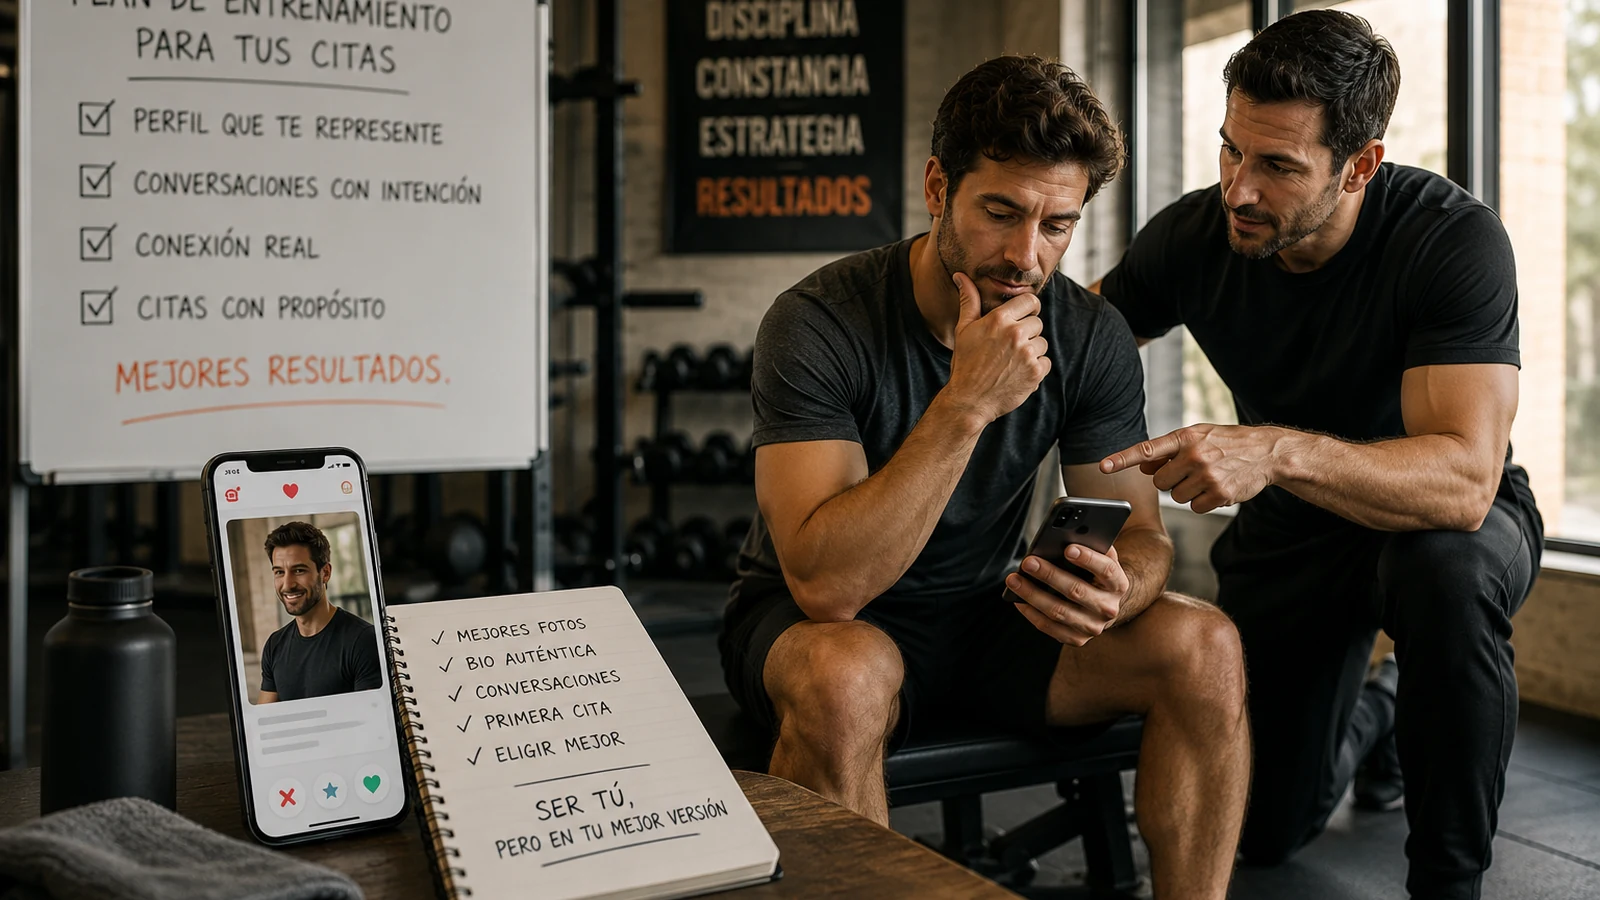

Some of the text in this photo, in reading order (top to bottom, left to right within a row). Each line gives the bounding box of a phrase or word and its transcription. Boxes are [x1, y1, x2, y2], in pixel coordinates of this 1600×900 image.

[706, 0, 860, 40] DISCIPLINA
[136, 26, 397, 75] PARA TUS CITAS
[696, 55, 870, 98] CONSTANCIA
[134, 107, 444, 146] PERFIL QUE TE REPRESENTE
[699, 115, 865, 157] ESTRATEGIA
[134, 170, 482, 205] CONVERSACIONES CON INTENCIÓN
[696, 176, 872, 217] RESULTADOS
[136, 226, 320, 259] CONEXIÓN REAL
[138, 289, 386, 321] CITAS CON PROPÓSITO
[115, 353, 450, 394] MEJORES RESULTADOS.
[456, 617, 587, 643] MEJORES FOTOS
[465, 643, 597, 671] BIO AUTÉNTICA
[475, 669, 621, 700] CONVERSACIONES
[484, 700, 613, 731] PRIMERA CITA
[495, 731, 626, 763] ELIGIR MEJOR
[535, 781, 634, 821] SER TÚ,
[494, 798, 729, 860] PERO EN TU MEJOR VERSIÓN
